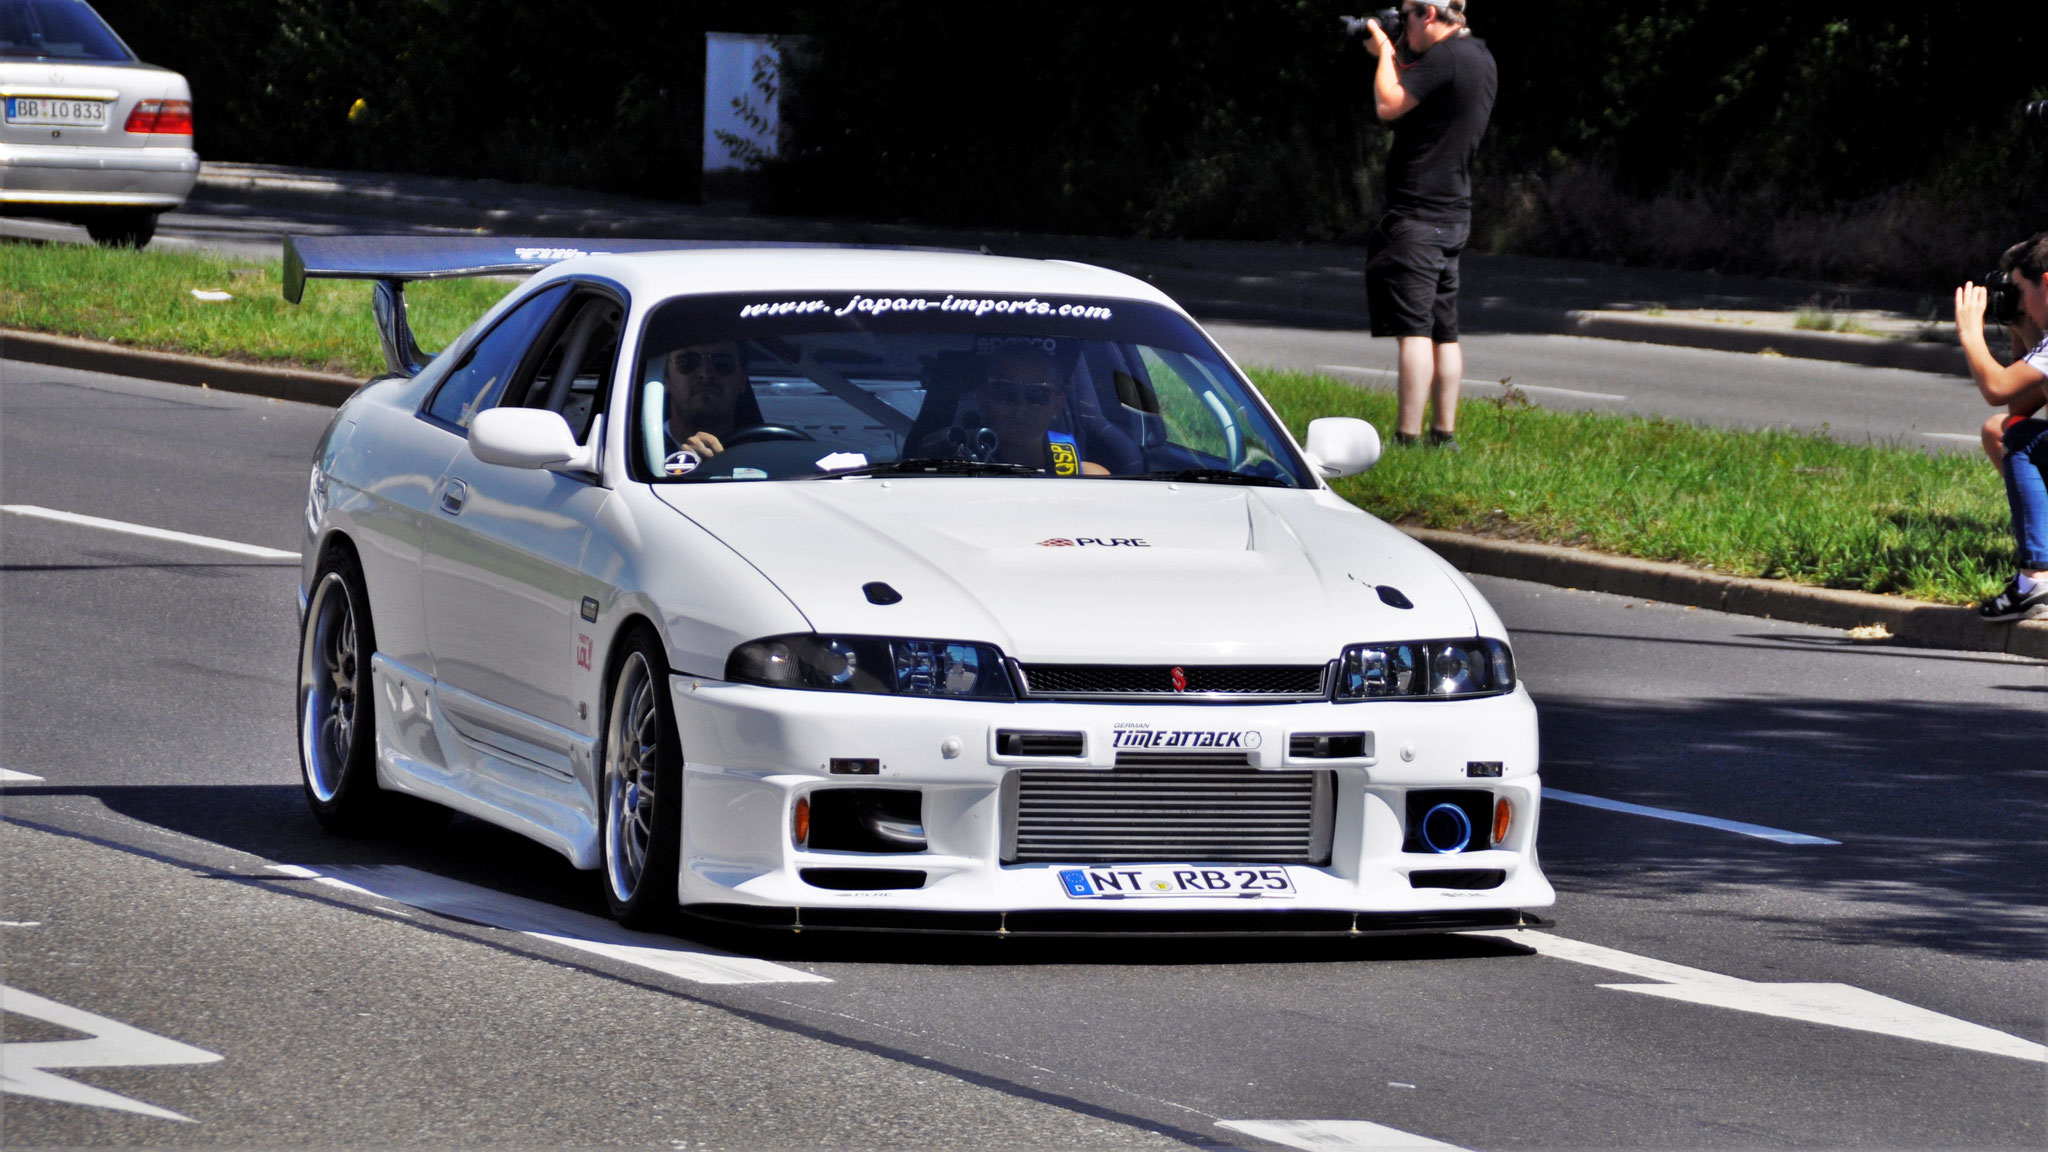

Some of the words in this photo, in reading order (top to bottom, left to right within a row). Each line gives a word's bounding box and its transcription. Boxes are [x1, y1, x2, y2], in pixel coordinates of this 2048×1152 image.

[18, 101, 38, 117] BB
[73, 103, 102, 119] 833
[1075, 538, 1151, 547] PURE
[1090, 871, 1143, 891] NT
